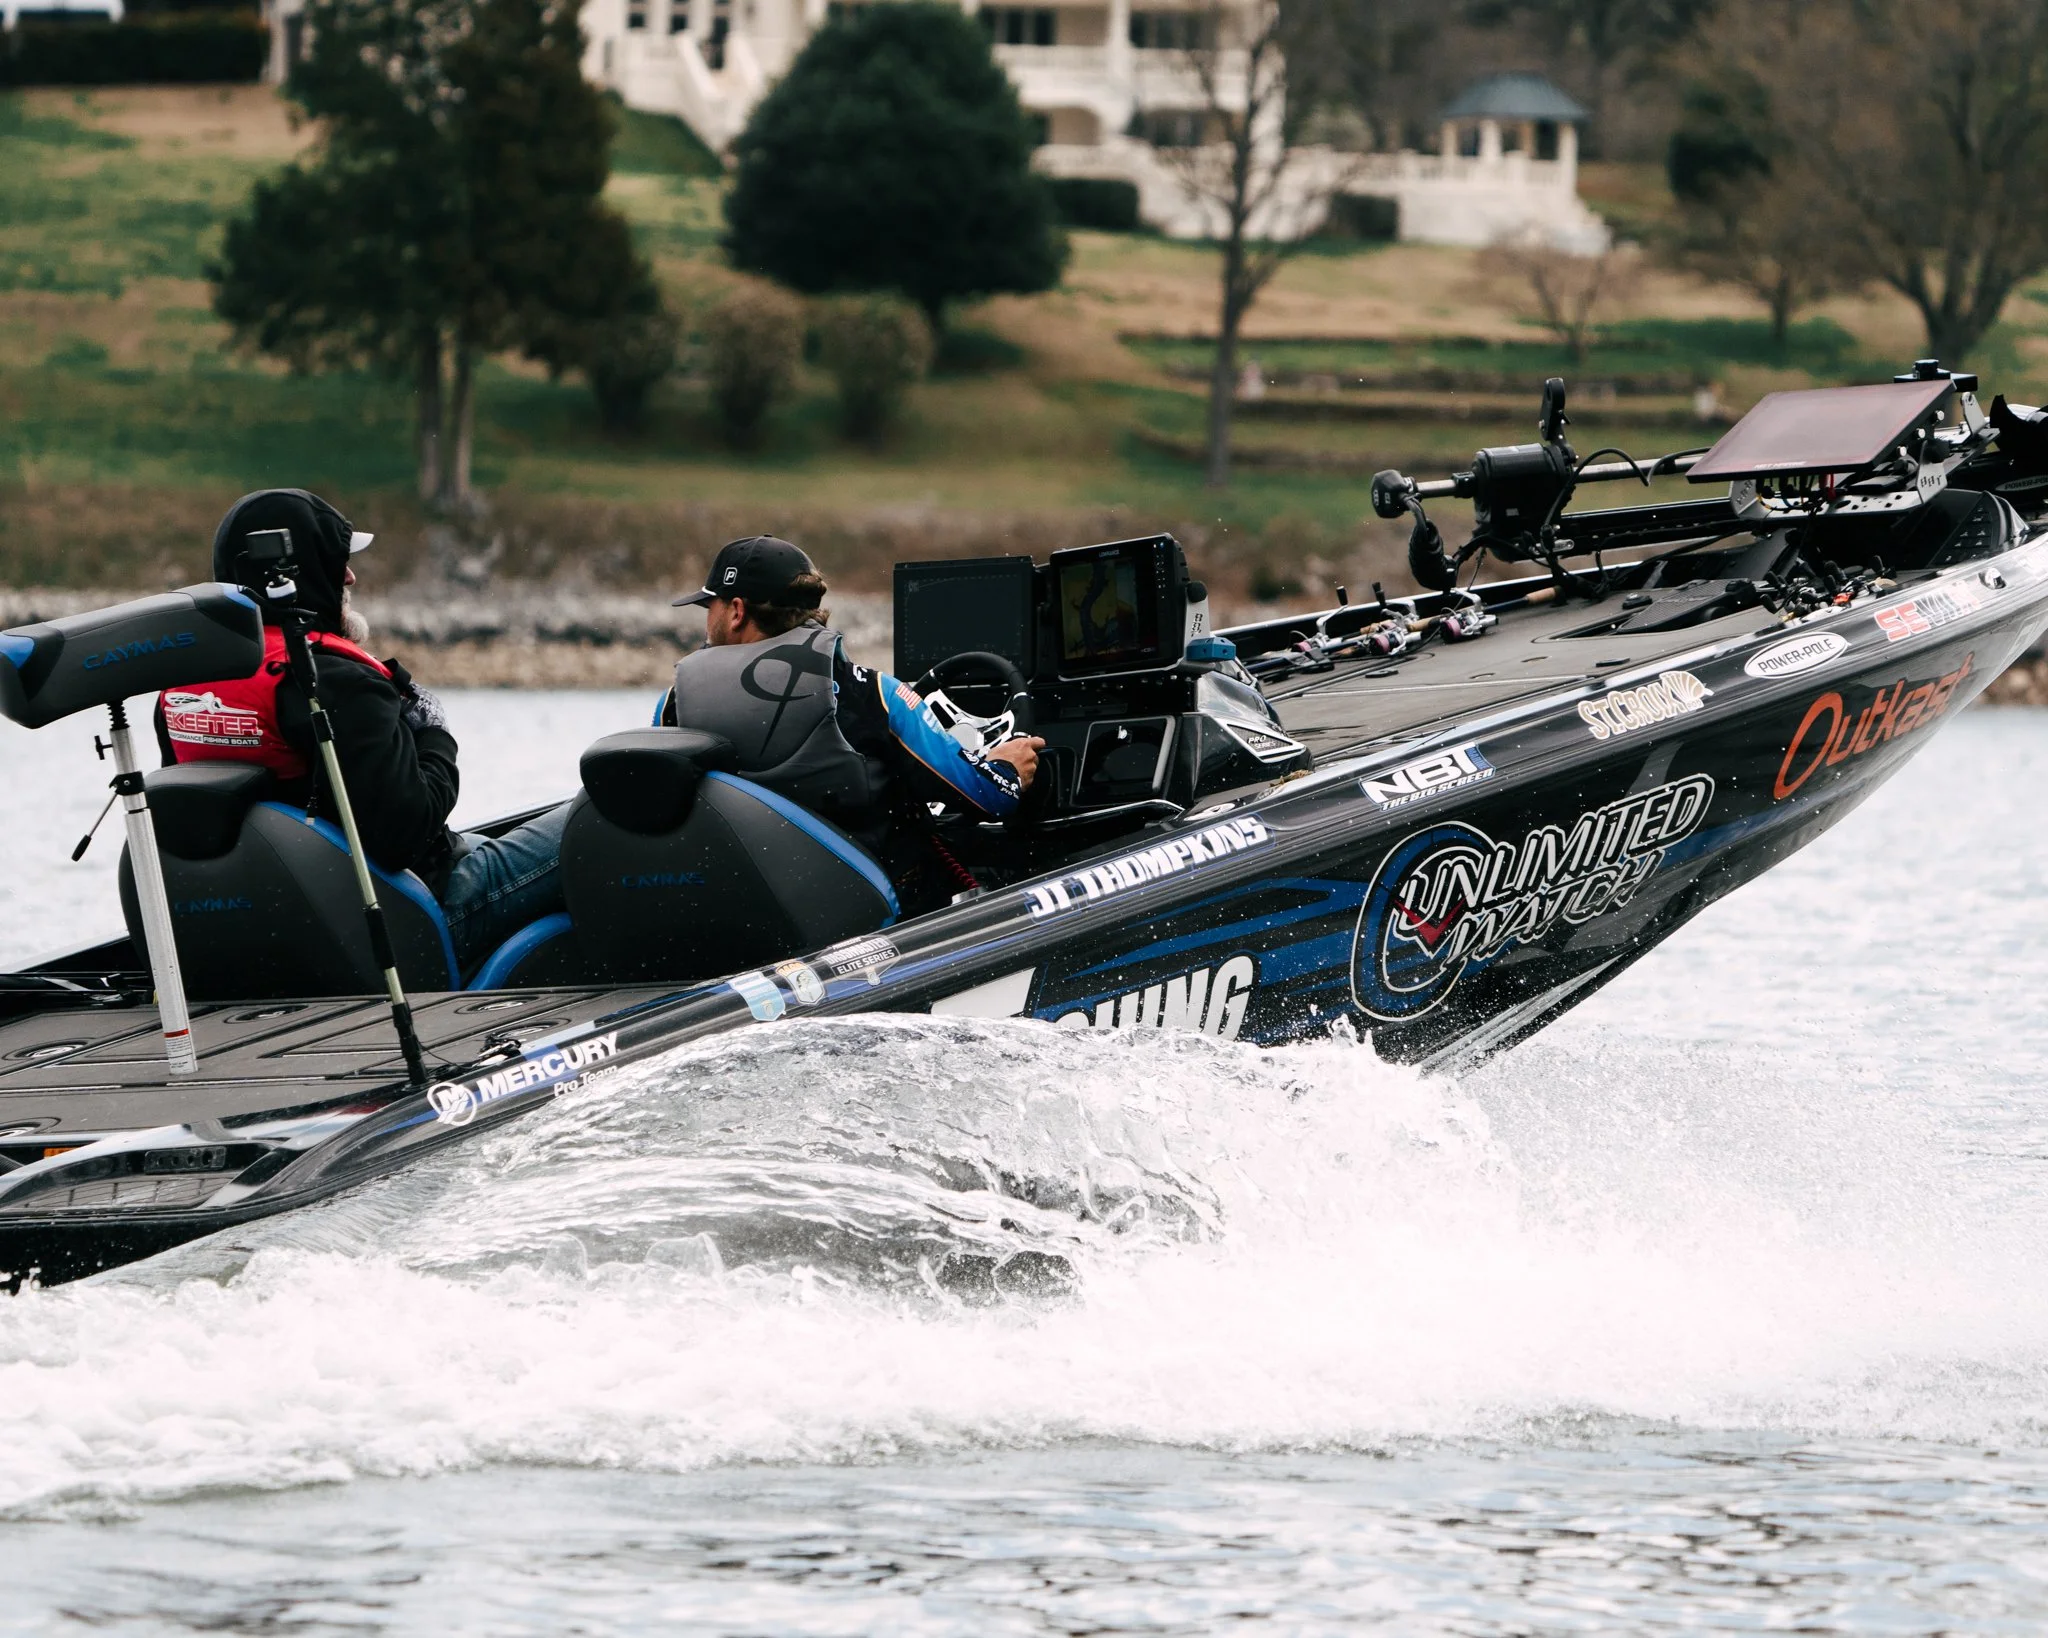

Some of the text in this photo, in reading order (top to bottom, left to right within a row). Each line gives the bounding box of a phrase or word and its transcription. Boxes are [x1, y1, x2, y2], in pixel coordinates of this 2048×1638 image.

[82, 632, 196, 671] CAYMAS
[1757, 638, 1836, 674] POWER-POLE
[165, 710, 259, 736] SKEETER
[203, 736, 230, 745] FISHING
[1248, 734, 1267, 744] PRO
[1772, 651, 1977, 801] Outkast
[1254, 741, 1277, 749] SERIES
[1360, 741, 1479, 804] NBT
[1381, 768, 1494, 811] THE BIG SCREEN
[1028, 816, 1269, 918] JT THOMPKINS
[1396, 778, 1710, 934] UNLIMITED
[619, 872, 706, 889] CAYMAS
[174, 897, 253, 914] CAYMAS
[1445, 846, 1666, 962] WATCH
[836, 949, 896, 974] ELITE SERIES
[475, 1031, 619, 1102] MERCURY
[553, 1064, 619, 1097] Pro Team
